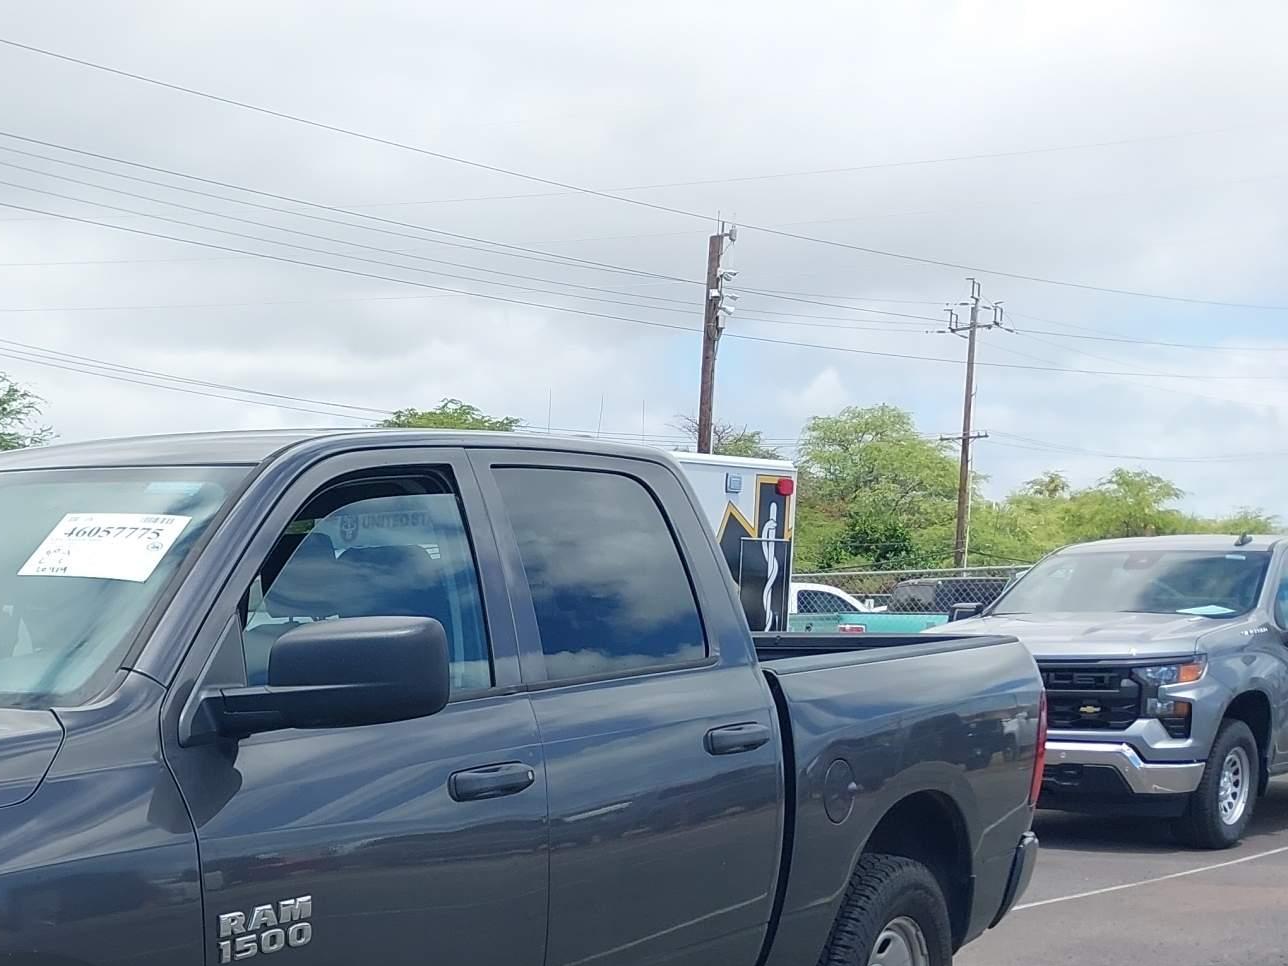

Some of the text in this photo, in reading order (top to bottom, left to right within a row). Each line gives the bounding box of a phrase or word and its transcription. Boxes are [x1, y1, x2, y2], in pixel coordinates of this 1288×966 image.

[64, 526, 164, 540] 46057775
[219, 895, 312, 938] RAM
[219, 922, 312, 964] 1500
